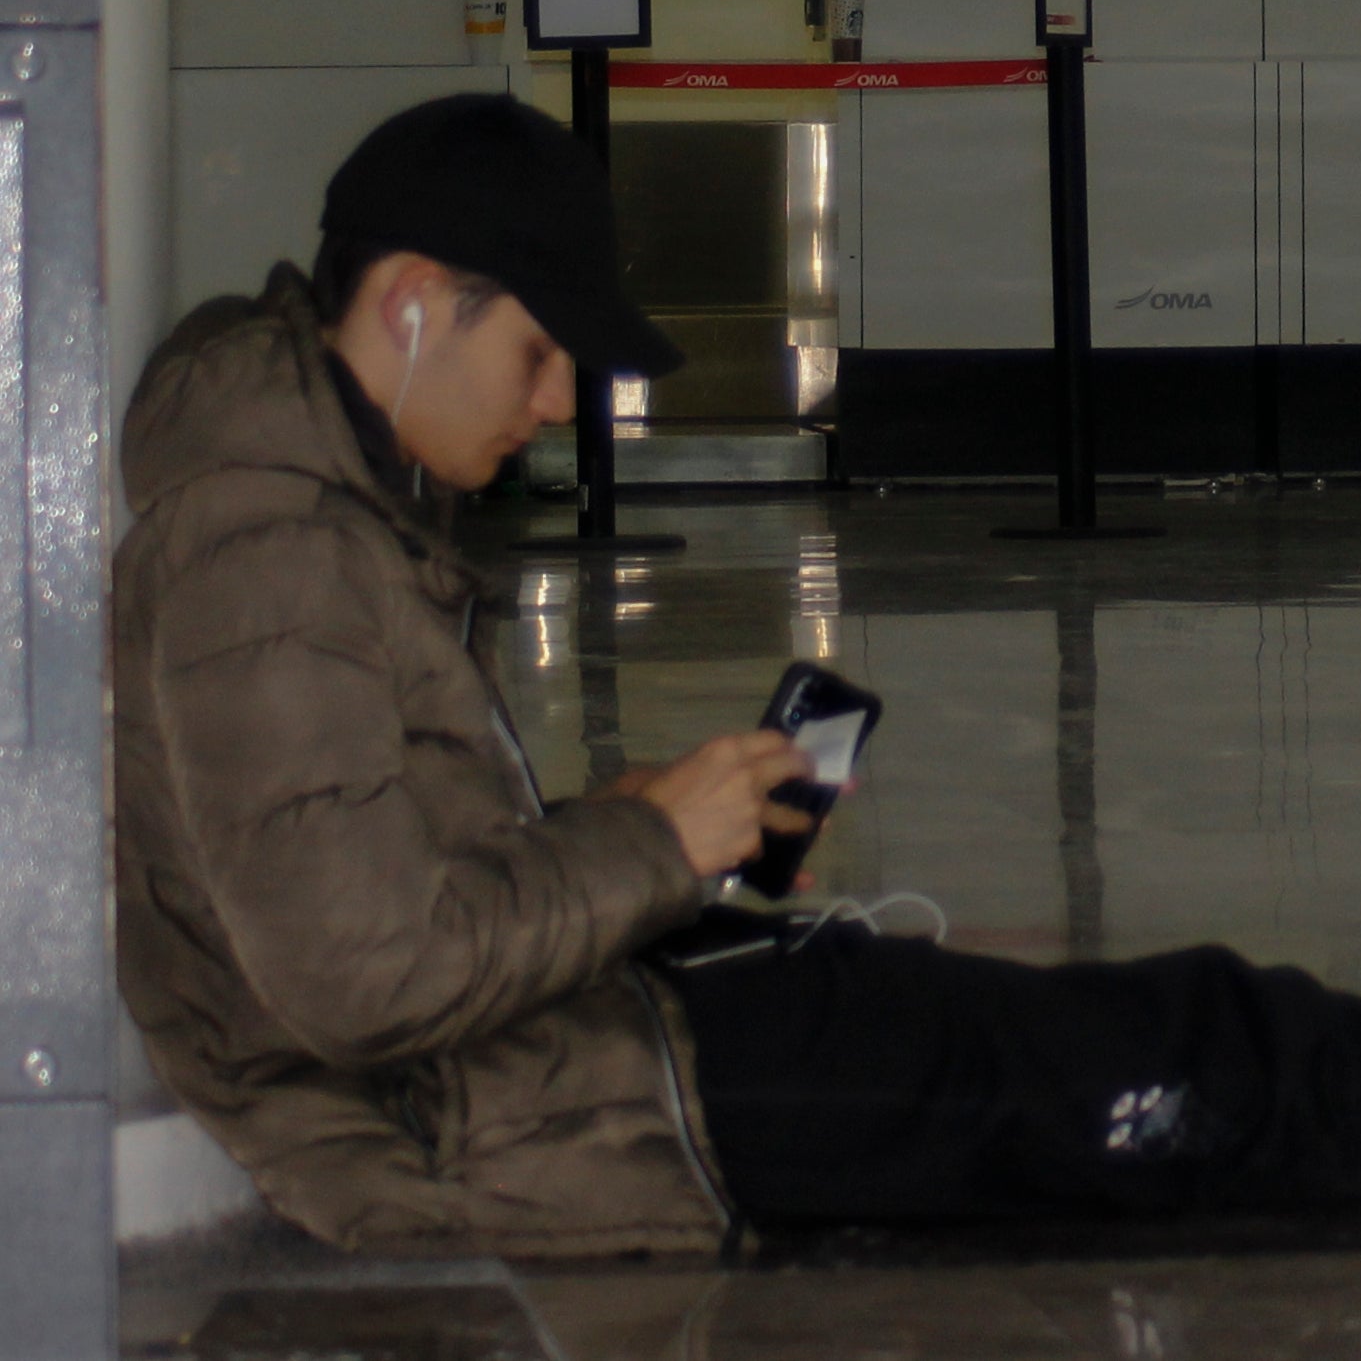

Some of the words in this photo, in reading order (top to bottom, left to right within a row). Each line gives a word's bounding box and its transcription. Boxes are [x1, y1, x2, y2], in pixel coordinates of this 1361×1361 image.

[686, 74, 729, 87] OMA
[857, 74, 899, 87] OMA
[1149, 293, 1213, 310] OMA
